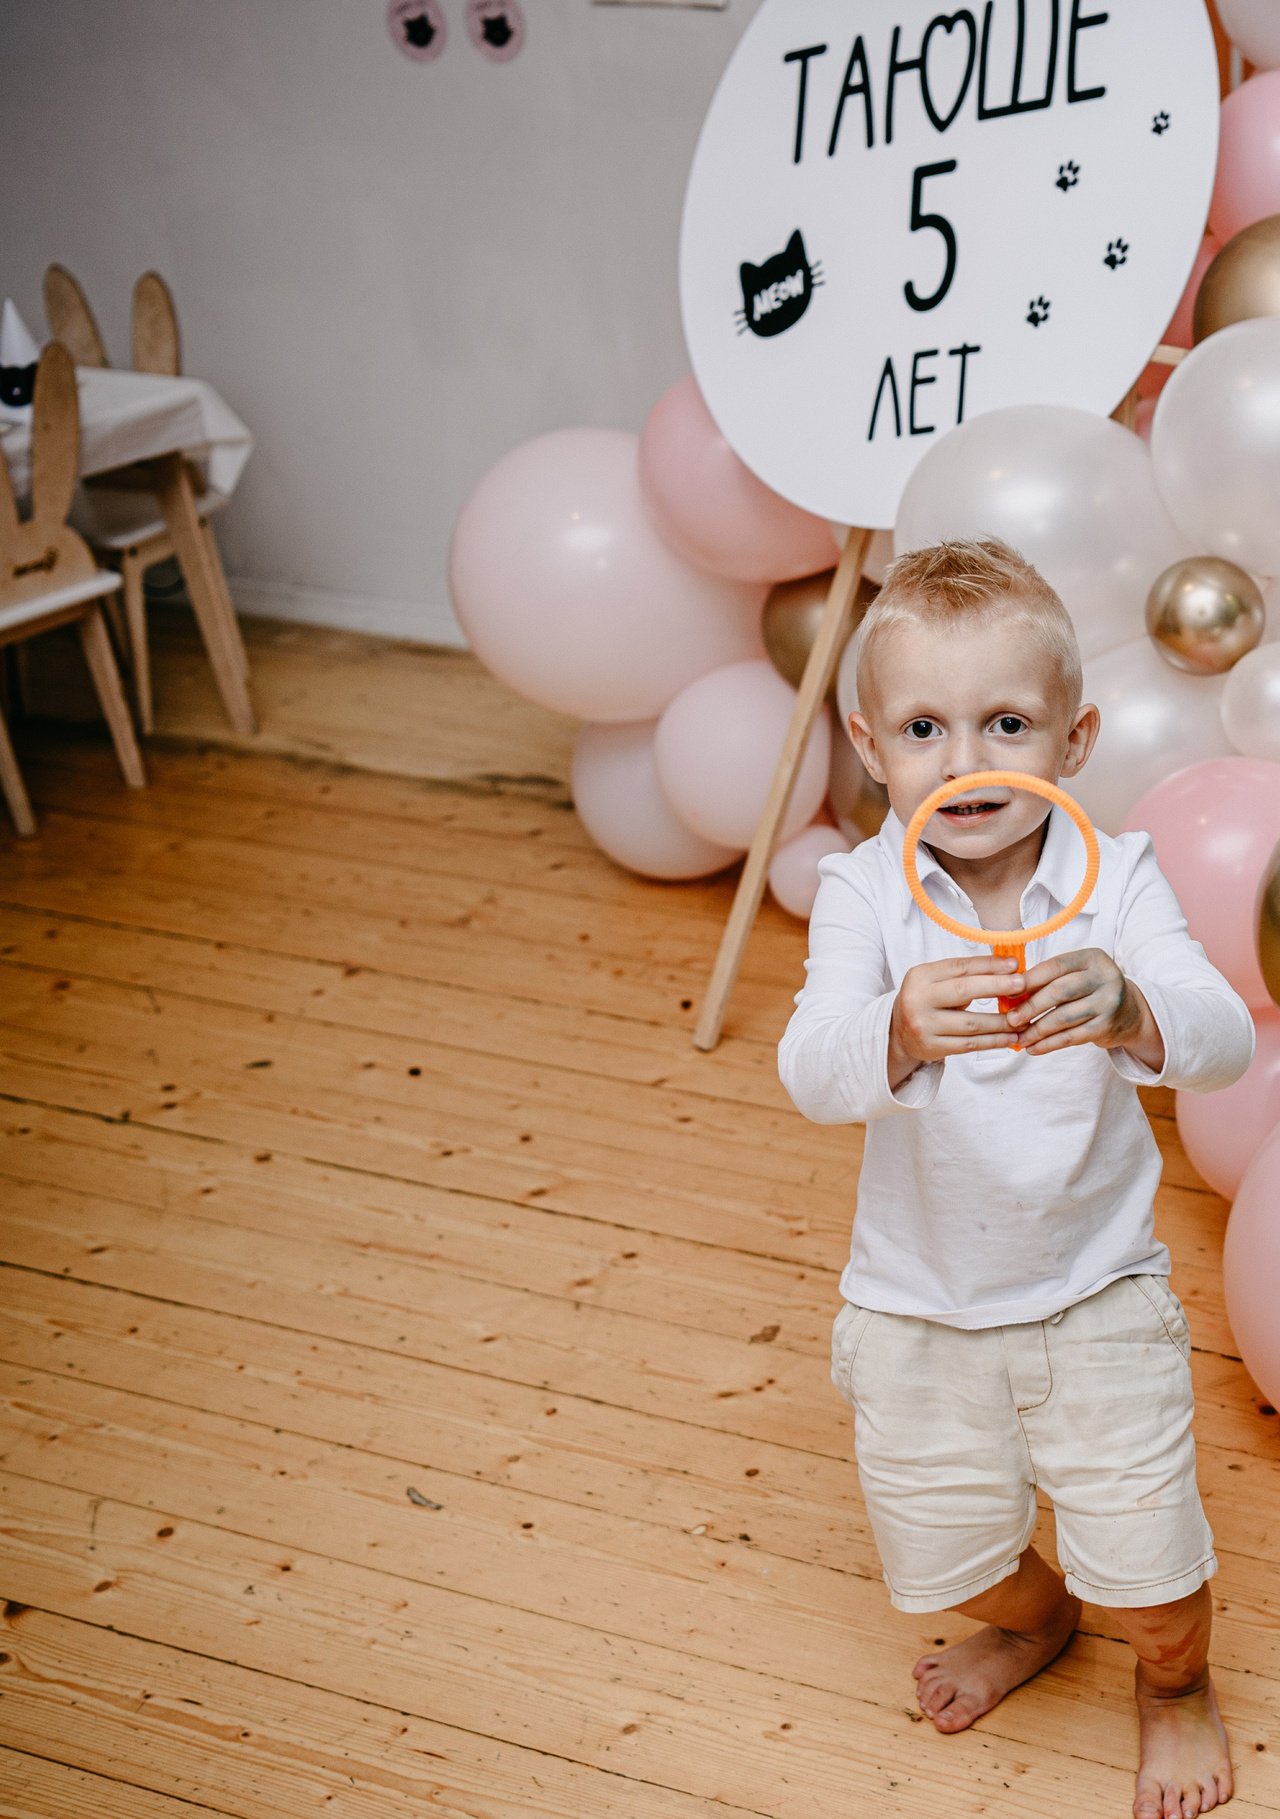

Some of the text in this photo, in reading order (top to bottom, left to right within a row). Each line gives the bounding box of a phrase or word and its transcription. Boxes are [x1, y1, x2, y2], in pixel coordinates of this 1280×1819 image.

[903, 159, 958, 312] 5
[753, 268, 804, 321] MEOW
[867, 343, 981, 441] ЛЕТ
